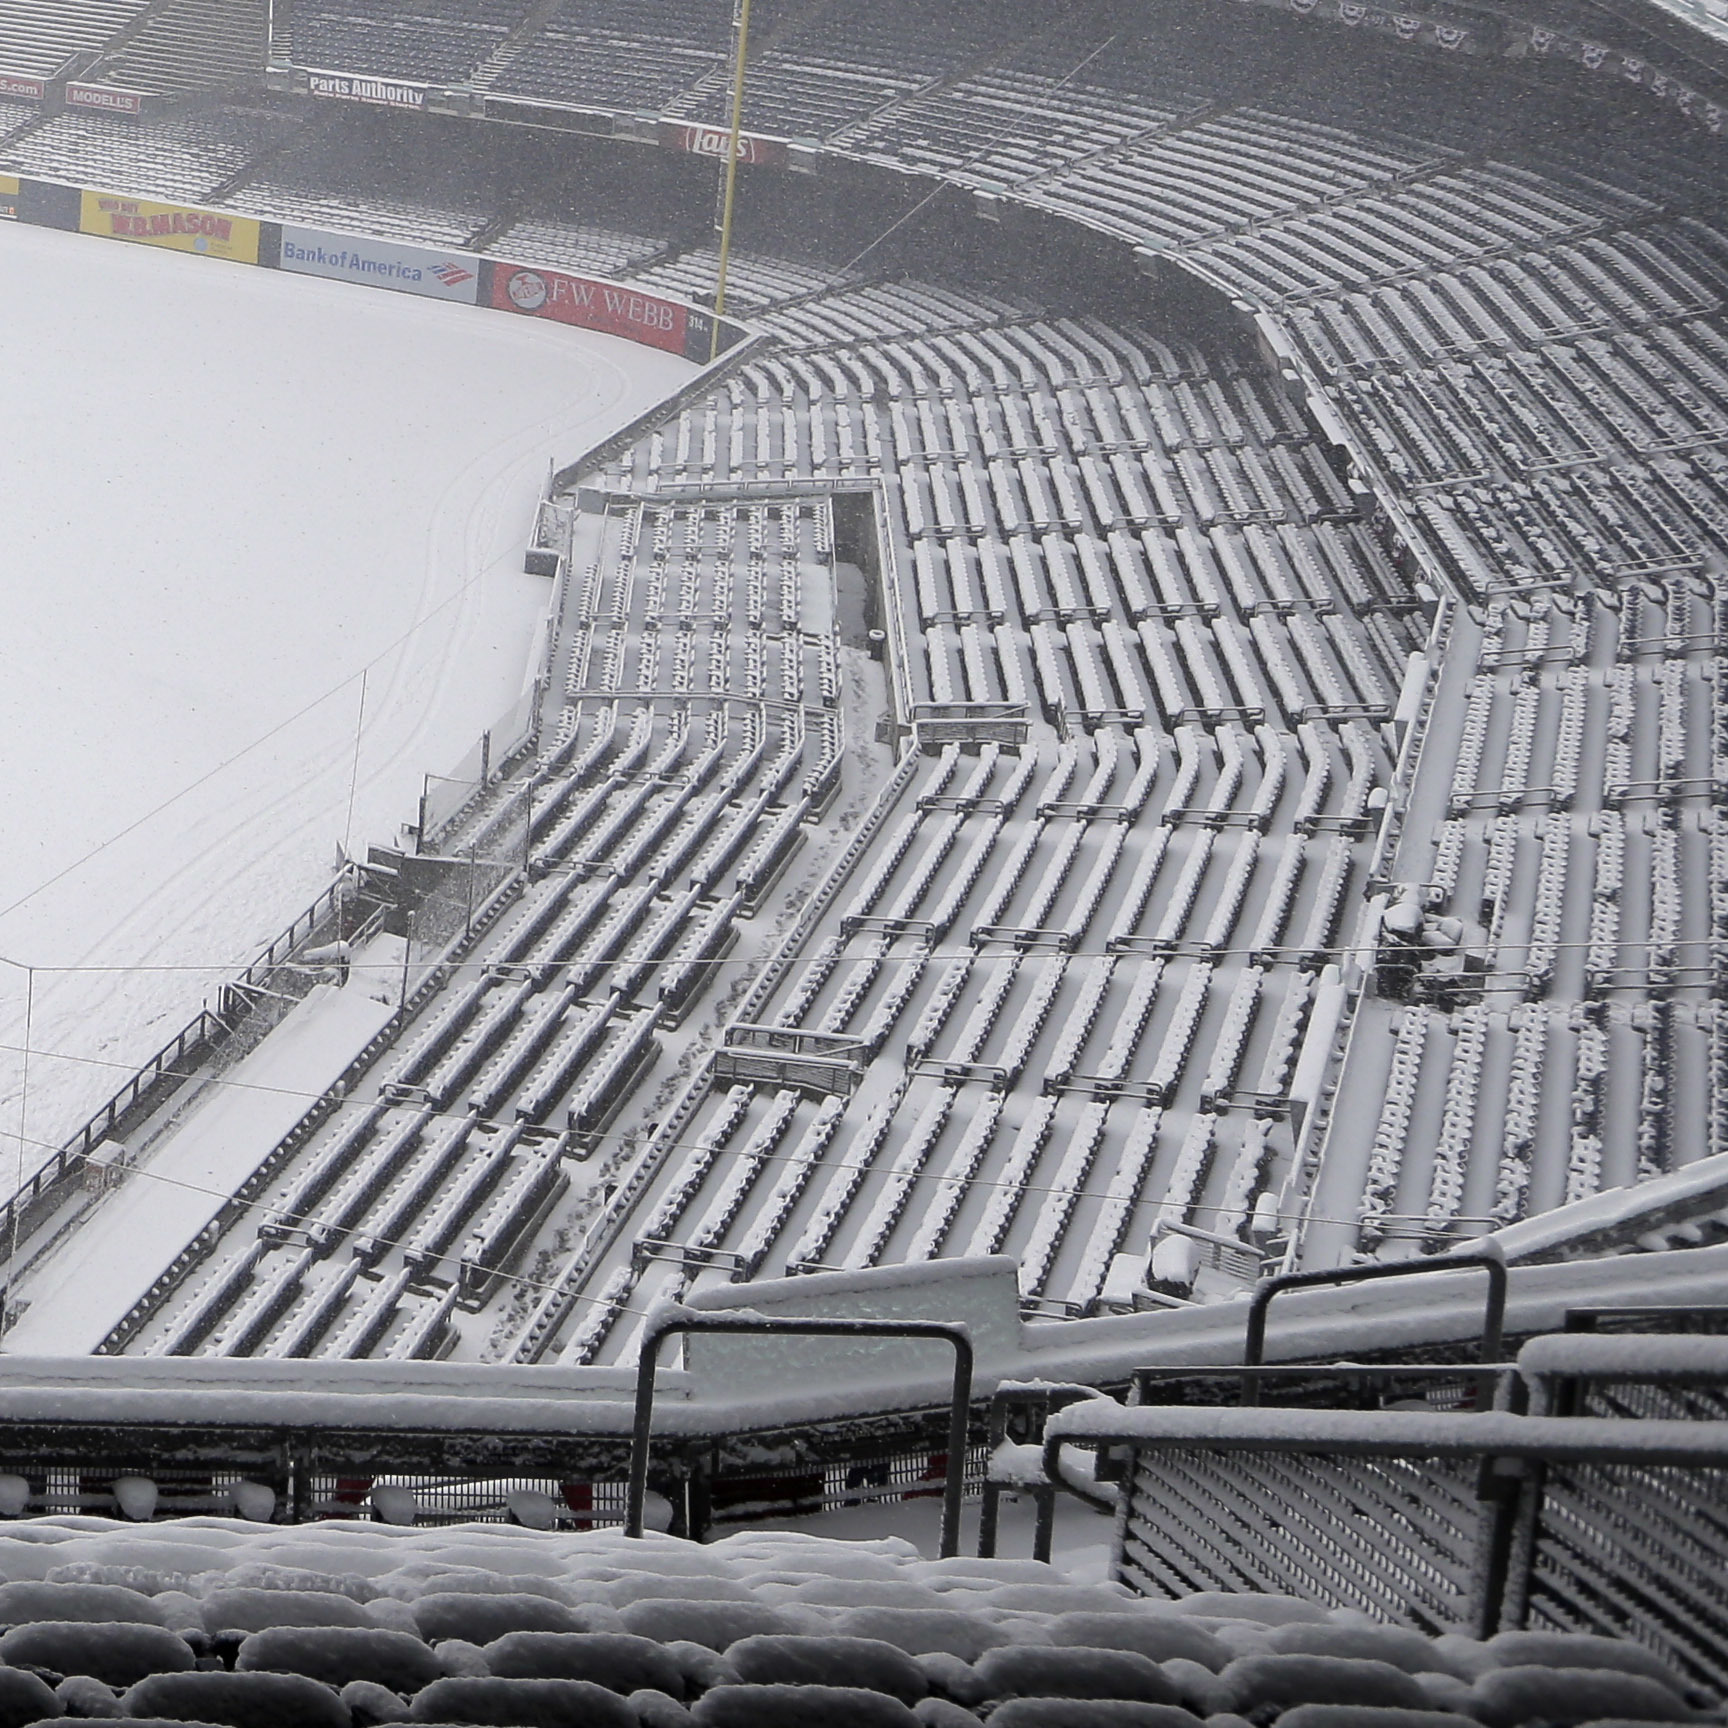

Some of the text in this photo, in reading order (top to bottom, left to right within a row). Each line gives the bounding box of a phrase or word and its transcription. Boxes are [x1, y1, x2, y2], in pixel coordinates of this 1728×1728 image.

[73, 89, 133, 110] MODELL'S
[310, 77, 349, 93] Parts
[352, 80, 424, 105] Authority
[284, 241, 422, 281] Bank of America
[603, 289, 673, 331] WEBB
